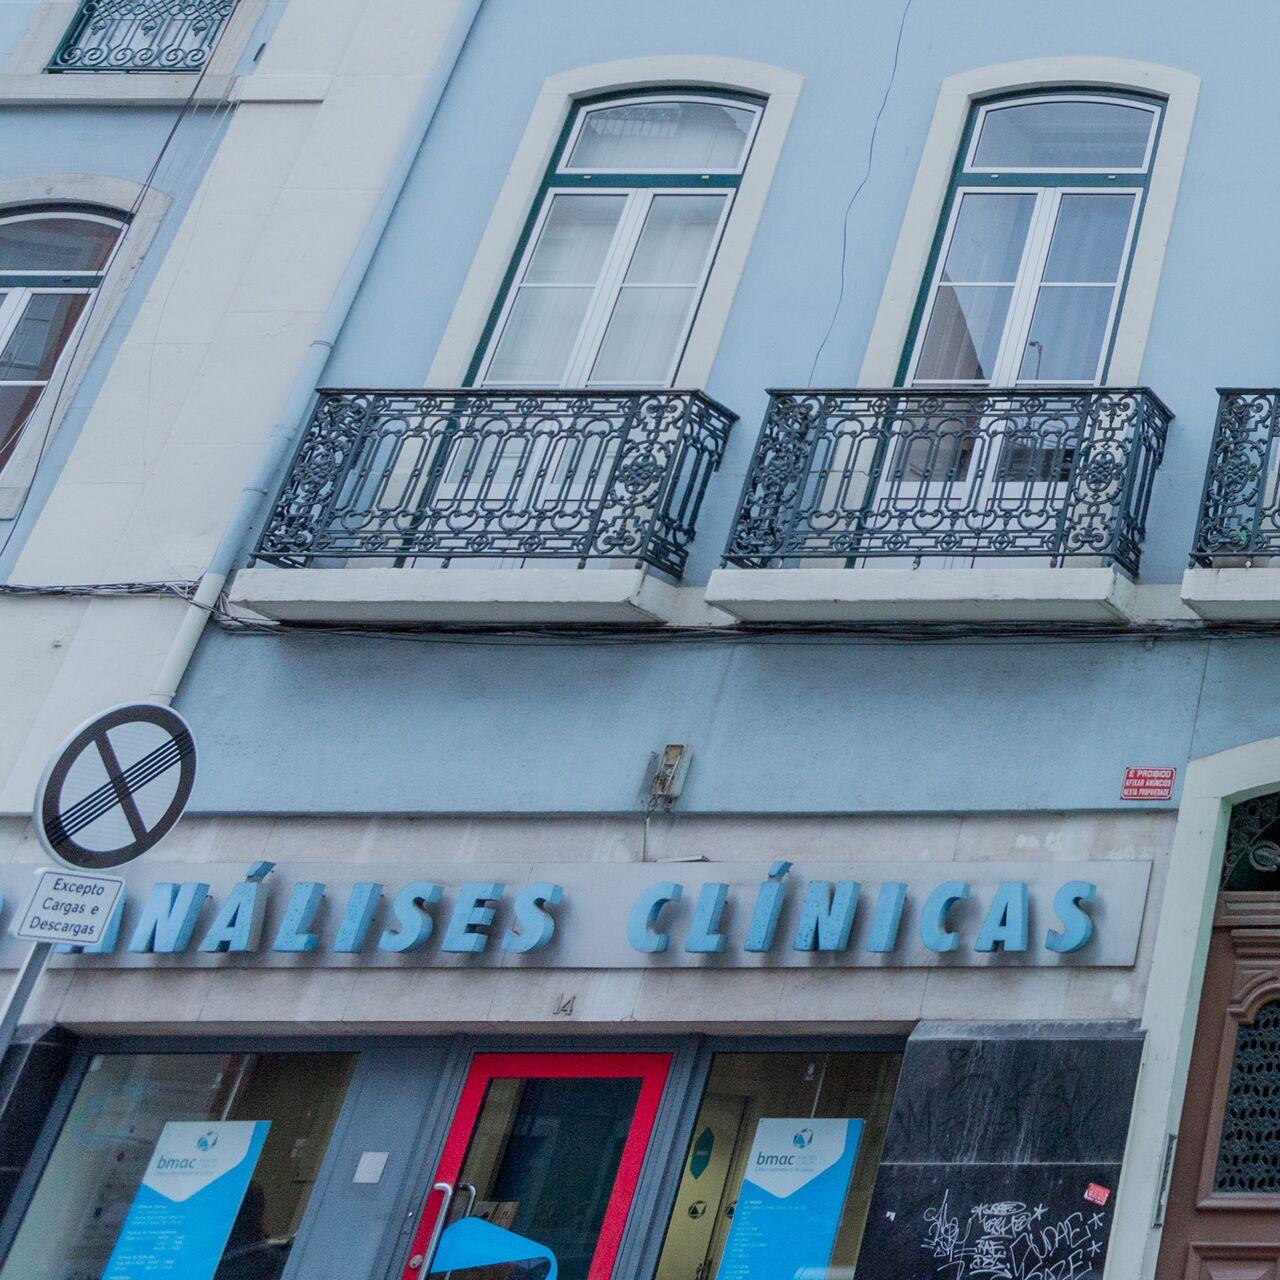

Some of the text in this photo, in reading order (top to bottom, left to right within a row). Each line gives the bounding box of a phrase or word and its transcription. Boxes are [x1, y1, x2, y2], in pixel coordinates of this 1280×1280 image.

[53, 877, 105, 897] Excepto
[42, 896, 100, 916] Cargas e
[626, 860, 1098, 954] CLÍNICAS
[29, 915, 96, 937] Descargas
[156, 1155, 197, 1170] bmac
[756, 1151, 796, 1167] bmac
